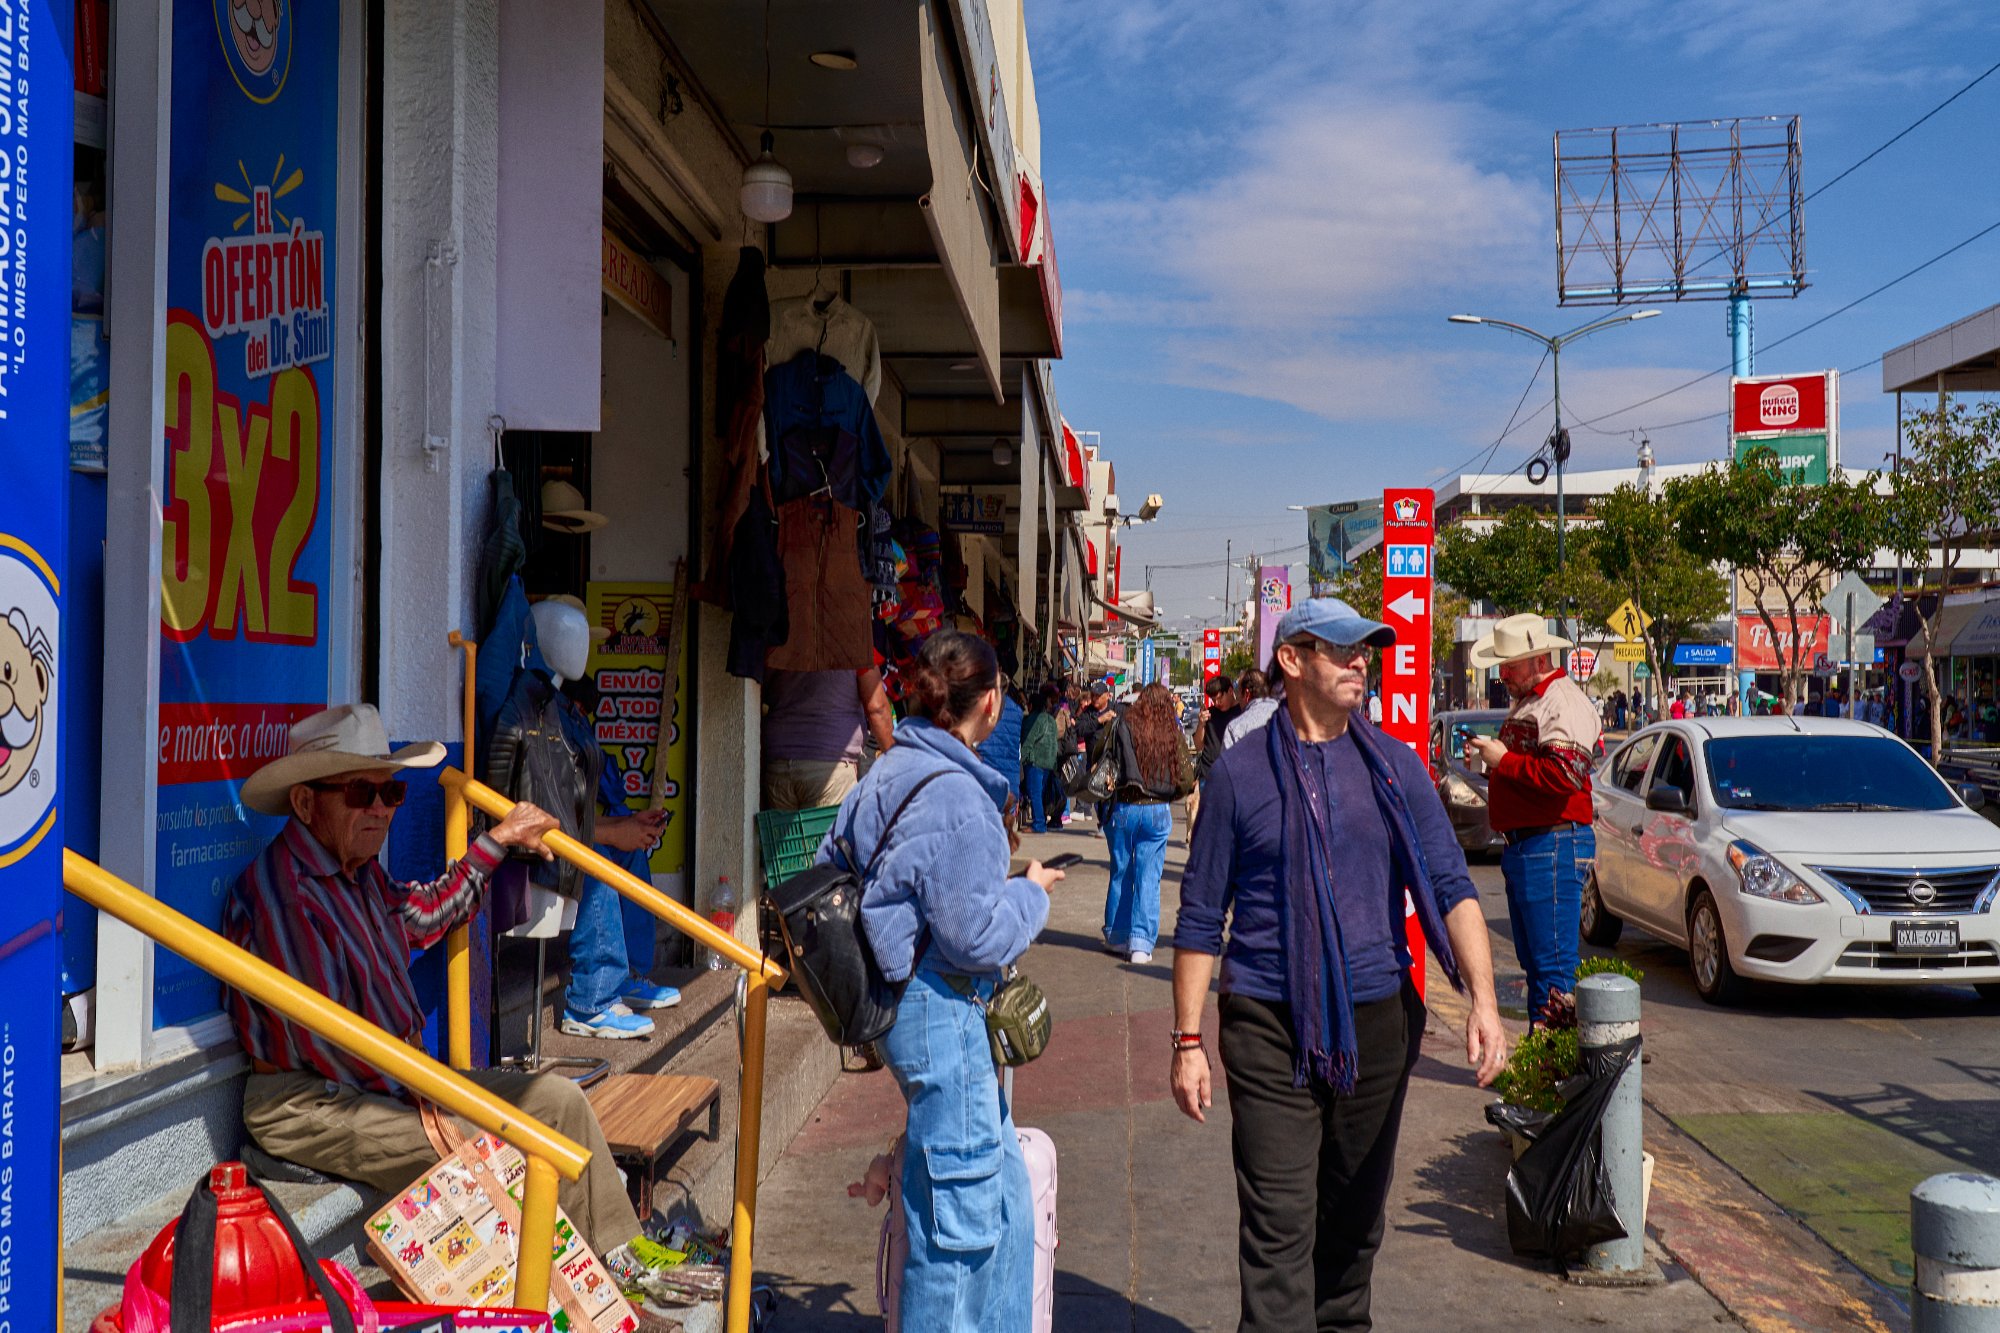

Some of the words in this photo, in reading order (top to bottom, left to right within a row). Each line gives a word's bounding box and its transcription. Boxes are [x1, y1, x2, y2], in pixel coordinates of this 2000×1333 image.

[18, 78, 29, 138] MAS
[16, 145, 28, 221] PERO
[256, 192, 271, 233] EL
[15, 228, 26, 319] MISMO
[205, 226, 322, 329] OFERTÓN
[247, 334, 267, 372] del
[270, 317, 291, 367] Dr.
[293, 309, 328, 362] Simi
[1762, 396, 1797, 406] BURGER
[1762, 405, 1797, 417] KING
[161, 308, 319, 645] 3X2
[1571, 663, 1595, 672] KNG
[1690, 648, 1717, 657] SALIDA
[601, 672, 666, 690] ENVÍO
[600, 700, 614, 714] A
[619, 700, 664, 714] TOD
[159, 723, 171, 764] e
[173, 716, 236, 764] martes
[239, 725, 251, 759] a
[599, 722, 673, 740] MÉXIC
[630, 751, 642, 764] Y
[156, 803, 194, 832] onsulta
[195, 801, 208, 828] los
[1, 1166, 13, 1227] MAS
[0, 1235, 11, 1313] PERO
[569, 1256, 593, 1281] HAPPY
